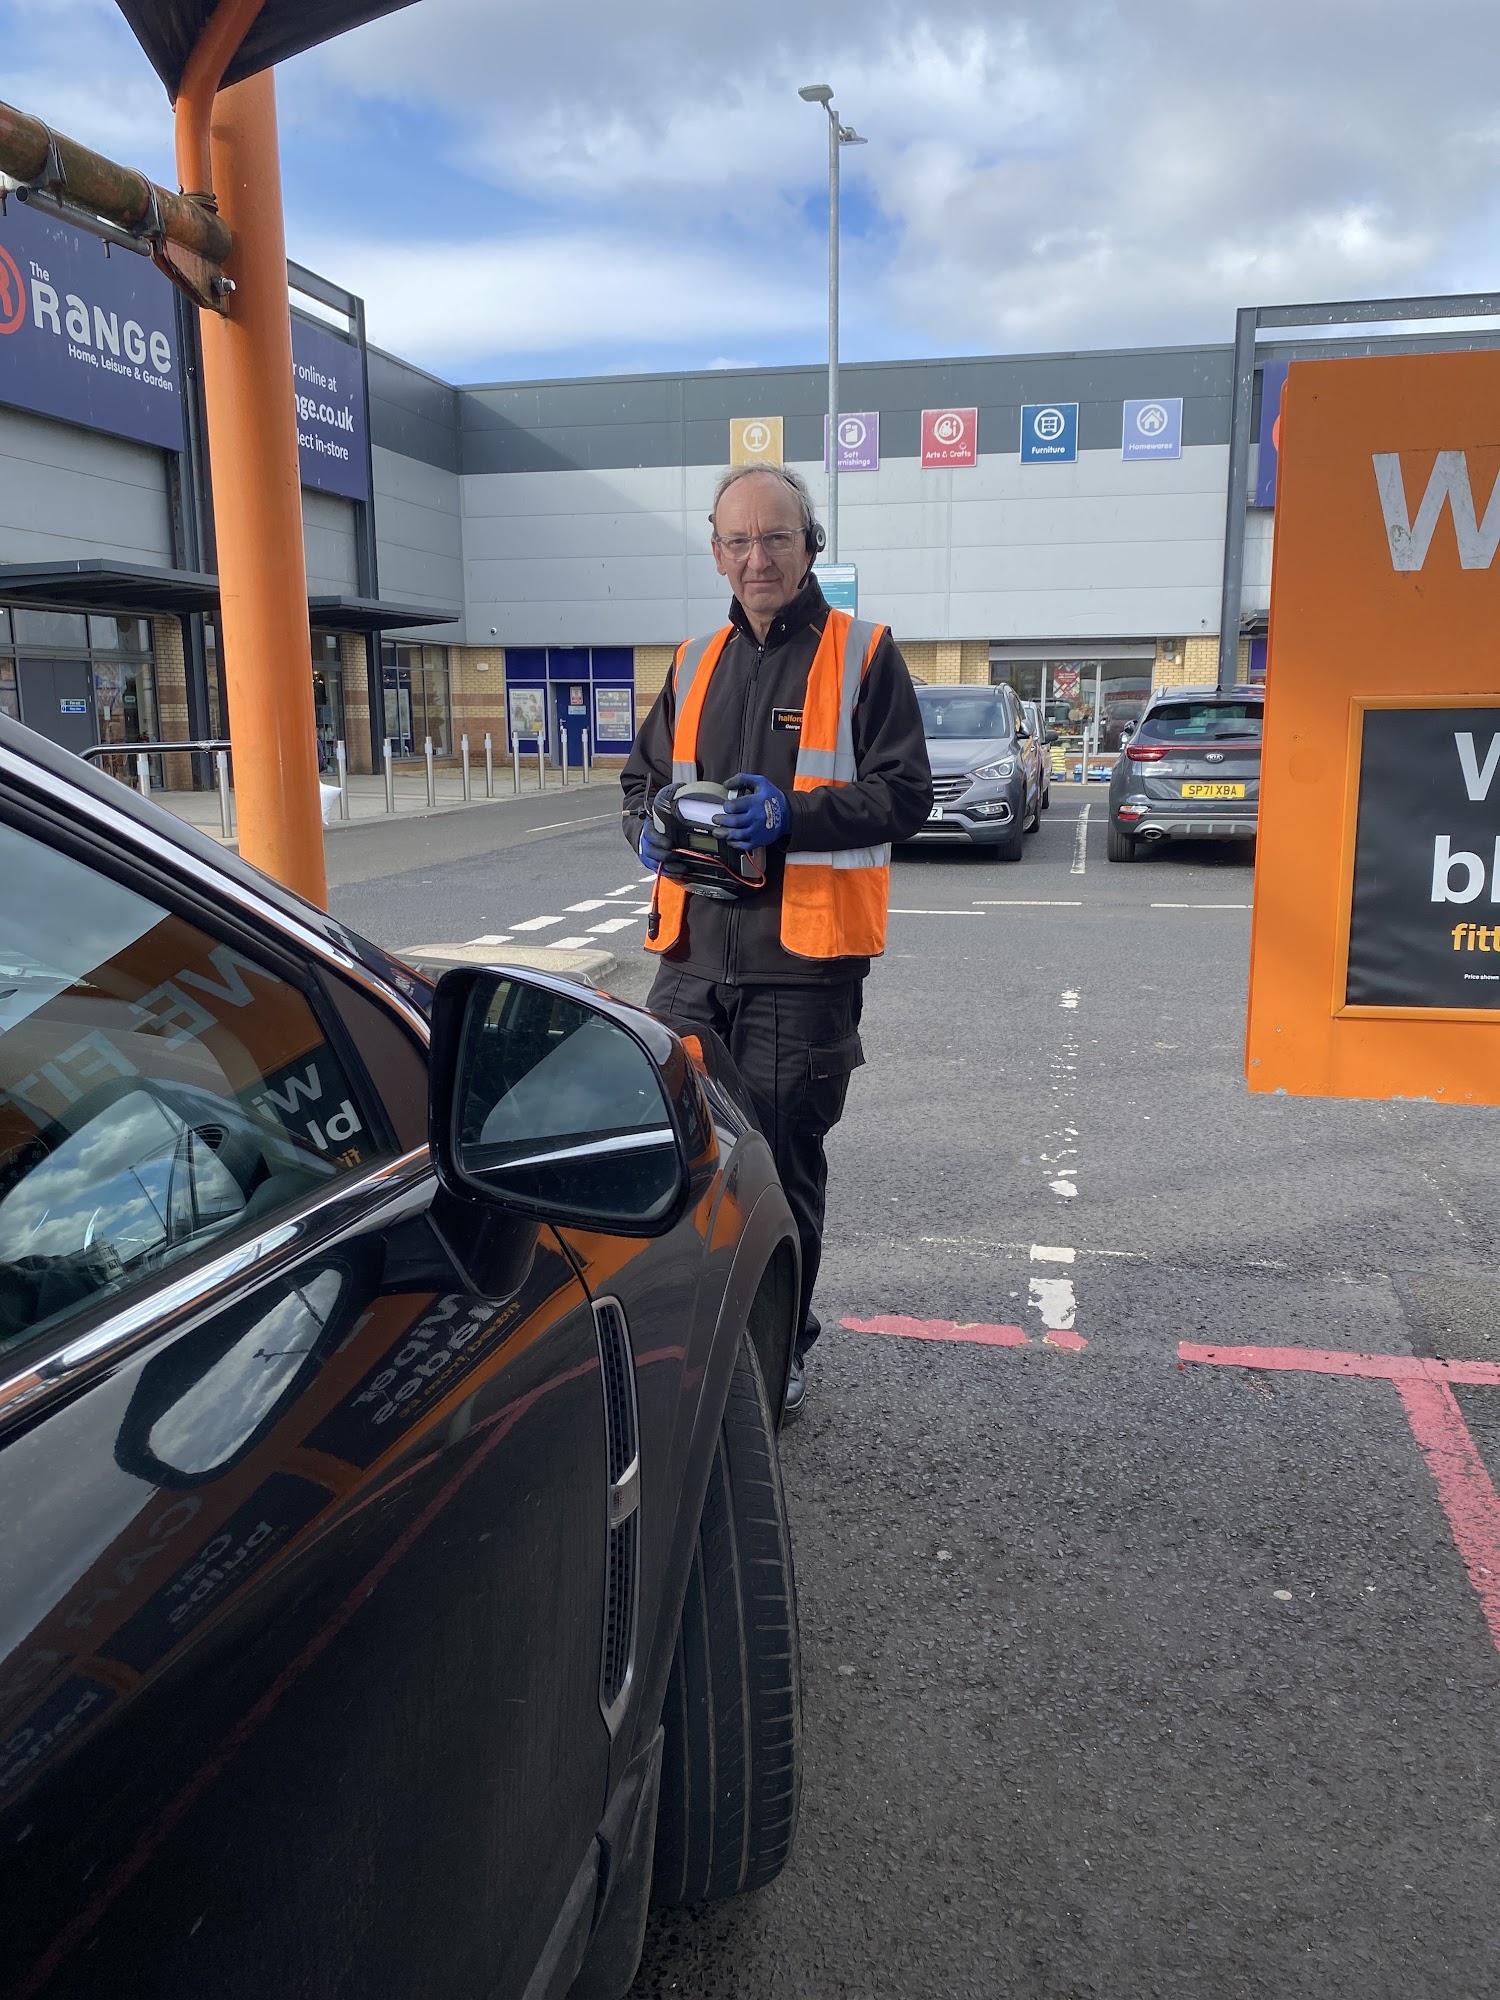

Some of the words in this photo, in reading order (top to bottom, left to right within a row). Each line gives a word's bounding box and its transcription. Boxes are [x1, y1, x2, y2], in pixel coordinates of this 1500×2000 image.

[30, 261, 50, 281] The
[68, 343, 99, 368] Home,
[101, 354, 132, 378] Leisure
[134, 366, 141, 381] &
[142, 370, 173, 392] Garden
[298, 365, 326, 388] online
[328, 377, 337, 392] at
[315, 434, 349, 461] in-store
[1031, 446, 1066, 455] Furniture
[1128, 442, 1173, 451] Homewares
[843, 451, 859, 459] Soft
[925, 451, 940, 459] Arts
[941, 450, 948, 458] &
[950, 450, 971, 458] Crafts
[1189, 785, 1213, 795] SP71
[1216, 785, 1237, 795] XBA
